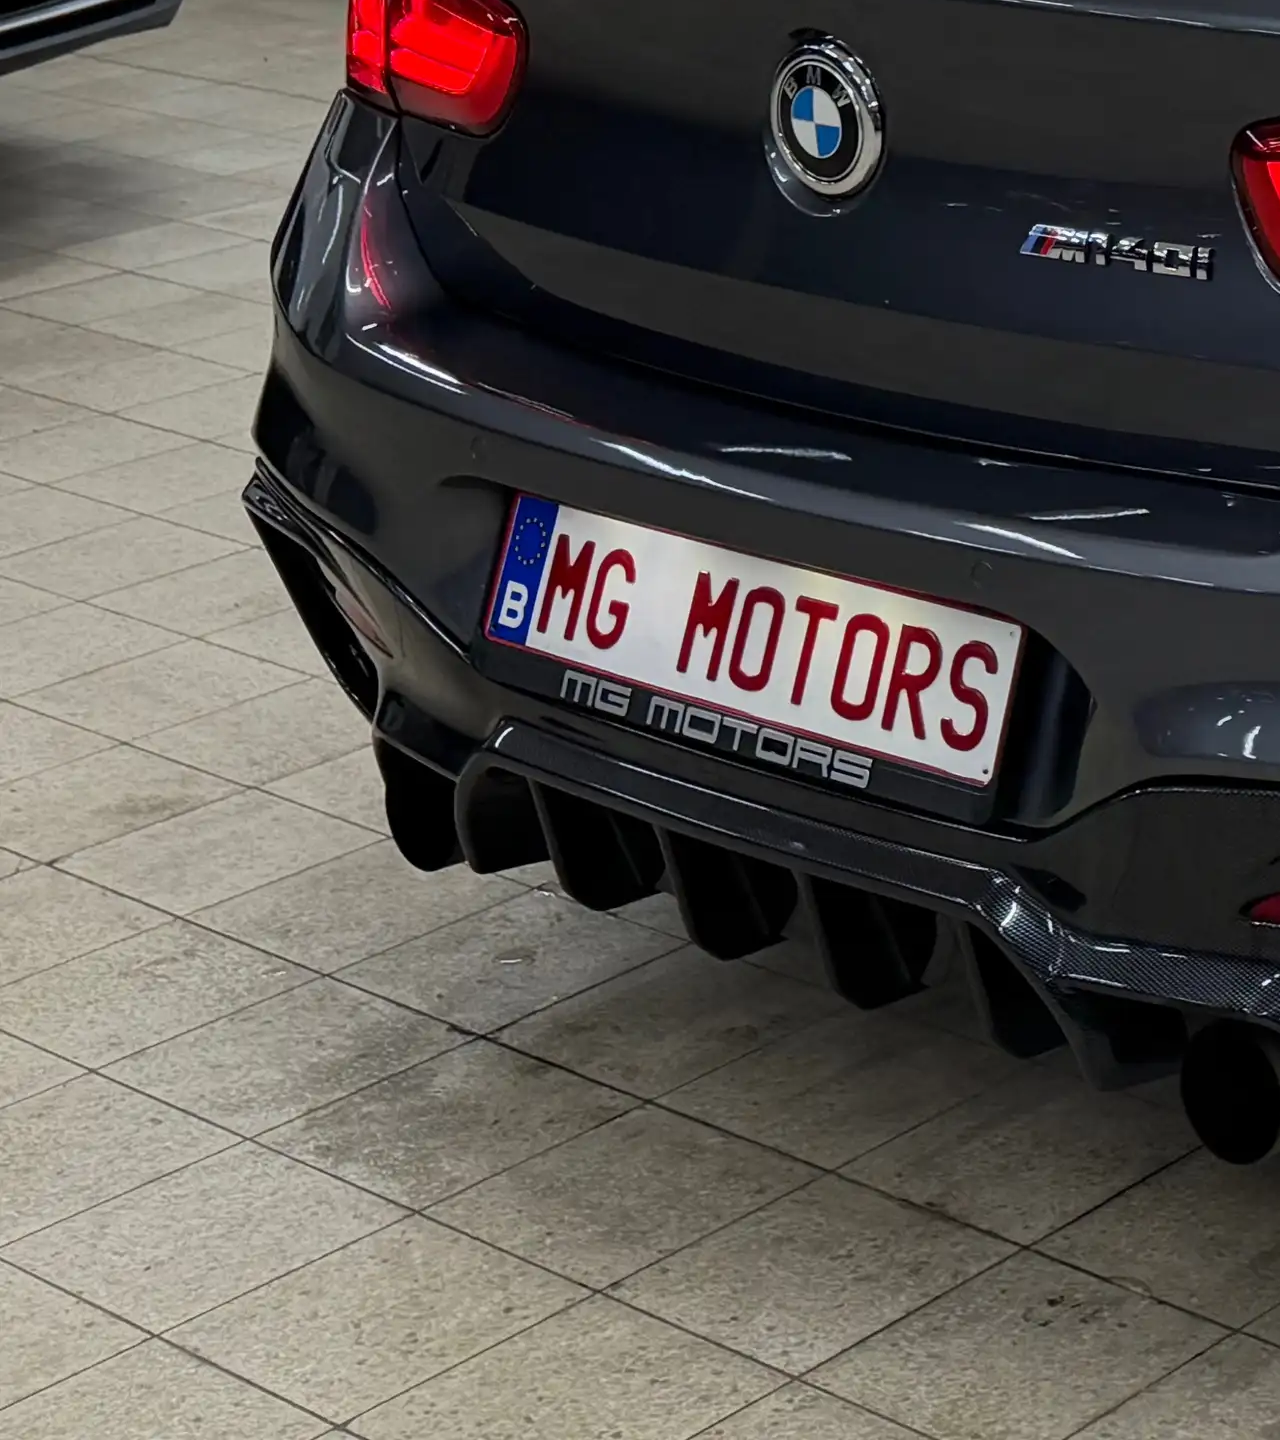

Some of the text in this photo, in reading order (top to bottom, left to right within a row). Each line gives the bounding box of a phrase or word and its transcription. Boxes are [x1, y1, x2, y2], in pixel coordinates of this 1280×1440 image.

[783, 65, 851, 107] BMW
[497, 582, 530, 629] B
[536, 533, 999, 752] MG MOTORS
[560, 669, 873, 789] MG MOTORS
